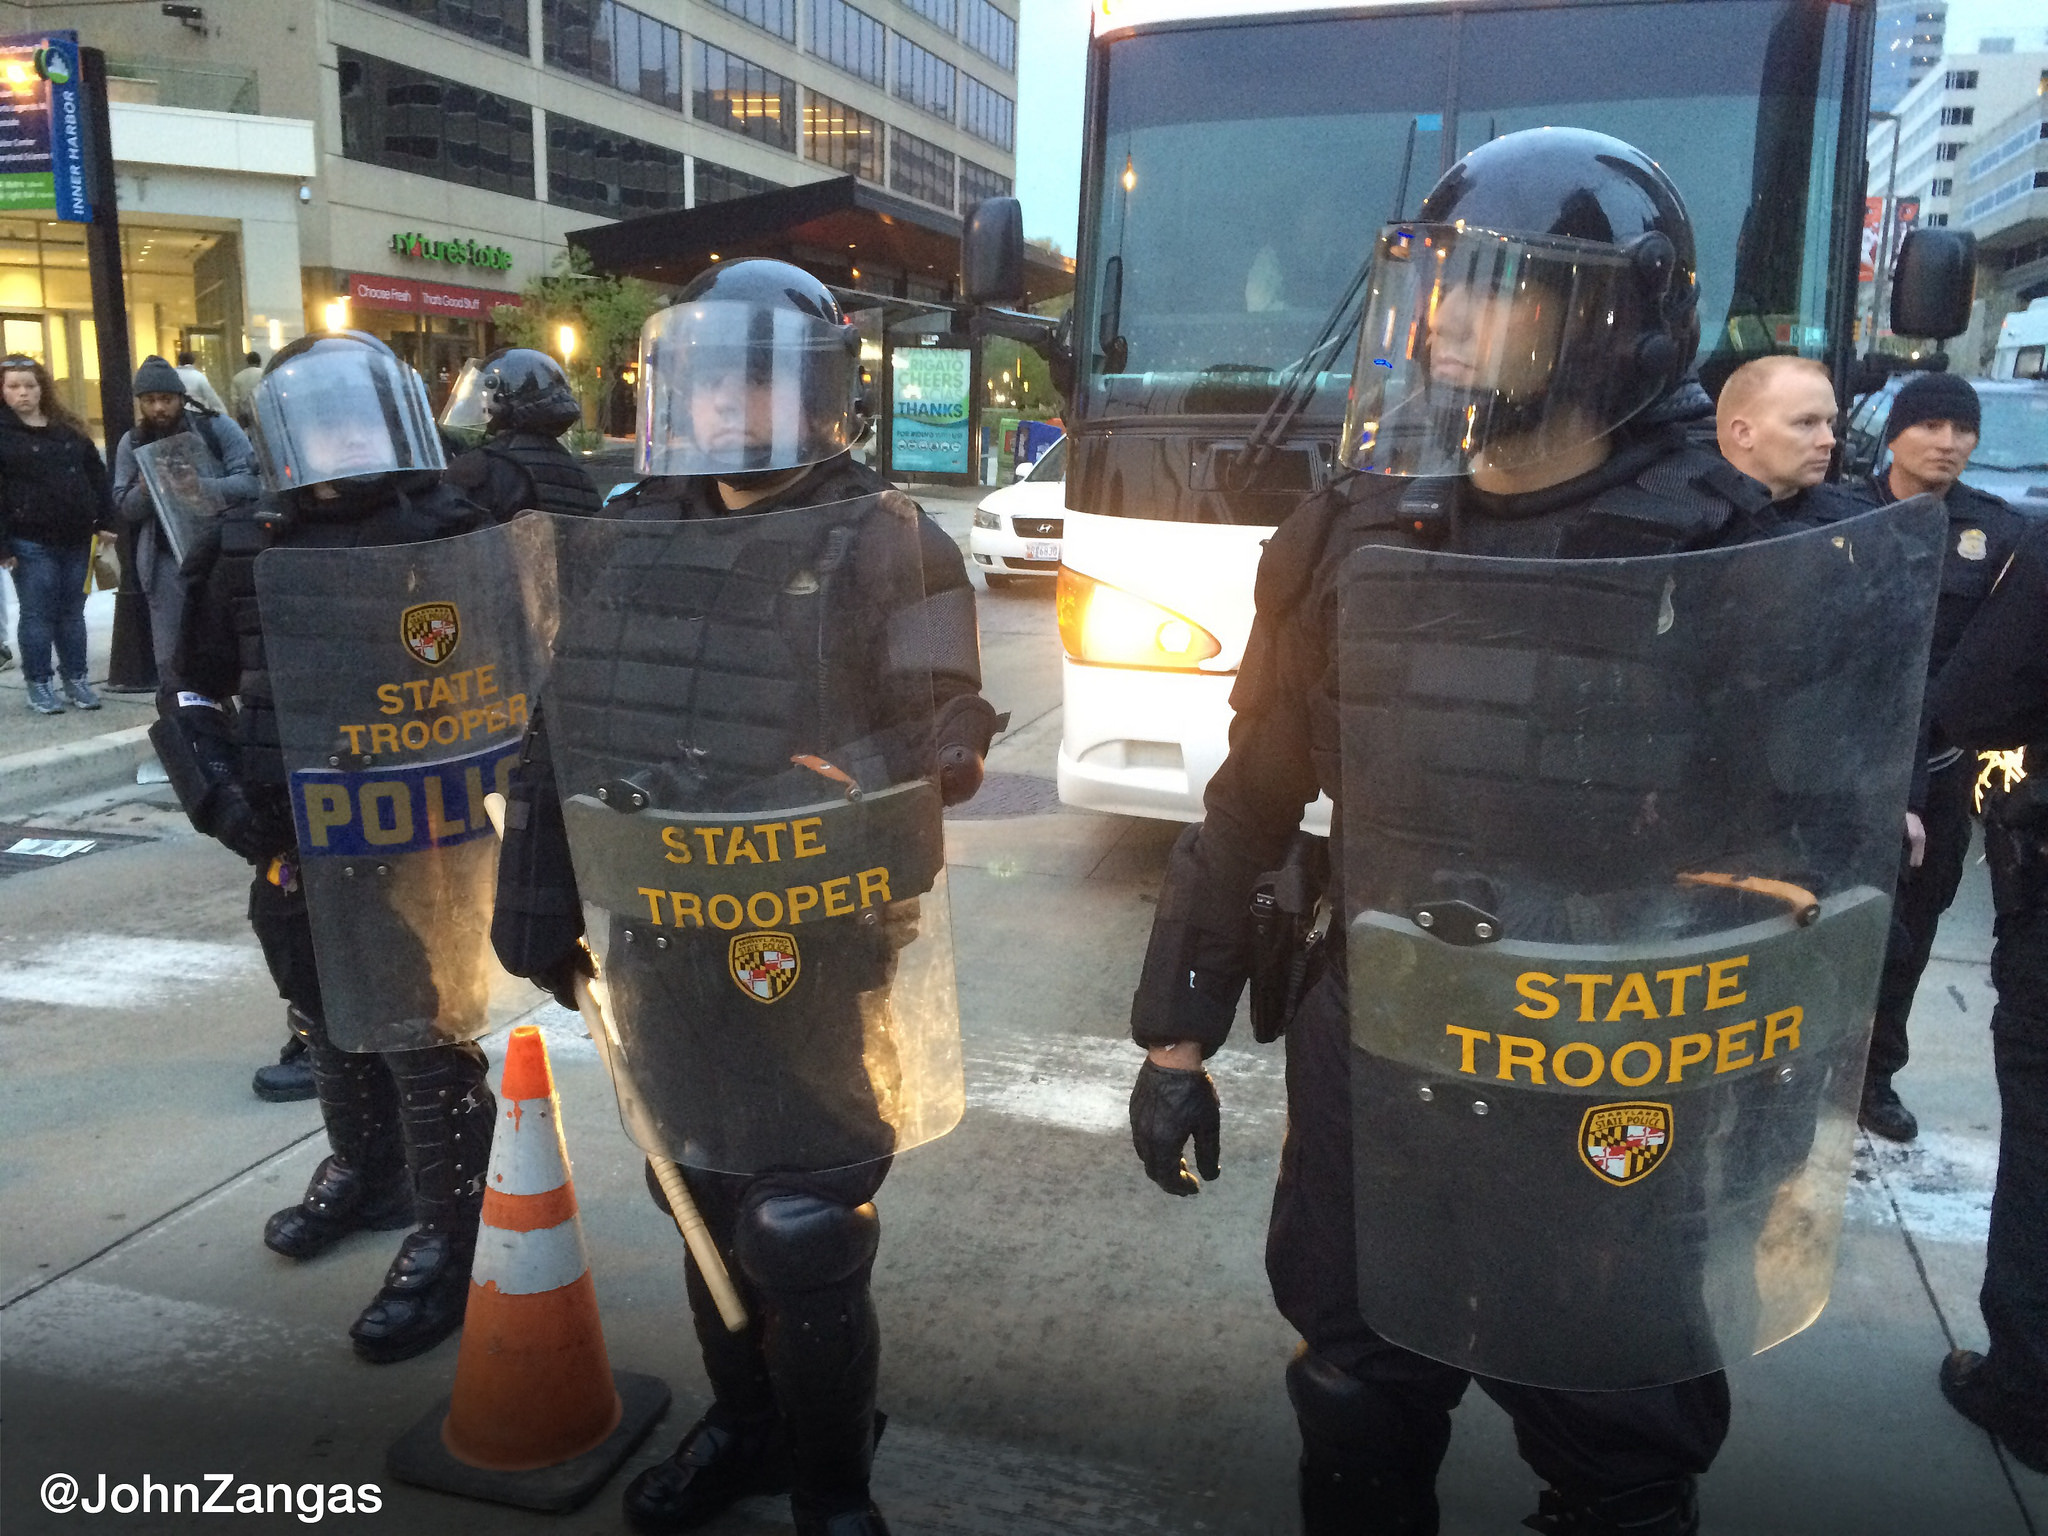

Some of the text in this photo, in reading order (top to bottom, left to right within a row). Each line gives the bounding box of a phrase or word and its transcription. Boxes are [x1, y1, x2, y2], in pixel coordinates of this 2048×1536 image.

[62, 91, 84, 215] INNER HARBOR
[357, 284, 412, 302] Choose Fresh
[898, 359, 964, 373] RIGATO
[898, 371, 963, 389] CHEERS
[898, 402, 963, 418] THANKS
[377, 664, 499, 715] STATE
[339, 692, 529, 755] TROOPER
[661, 816, 827, 865] STATE
[637, 866, 892, 930] TROOPER
[738, 943, 790, 953] STATE POLICE
[739, 937, 788, 947] MARYLAND
[1513, 954, 1750, 1022] STATE
[1446, 1005, 1804, 1087] TROOPER
[1595, 1116, 1661, 1129] STATE POLICE
[1597, 1110, 1659, 1120] MARYLAND
